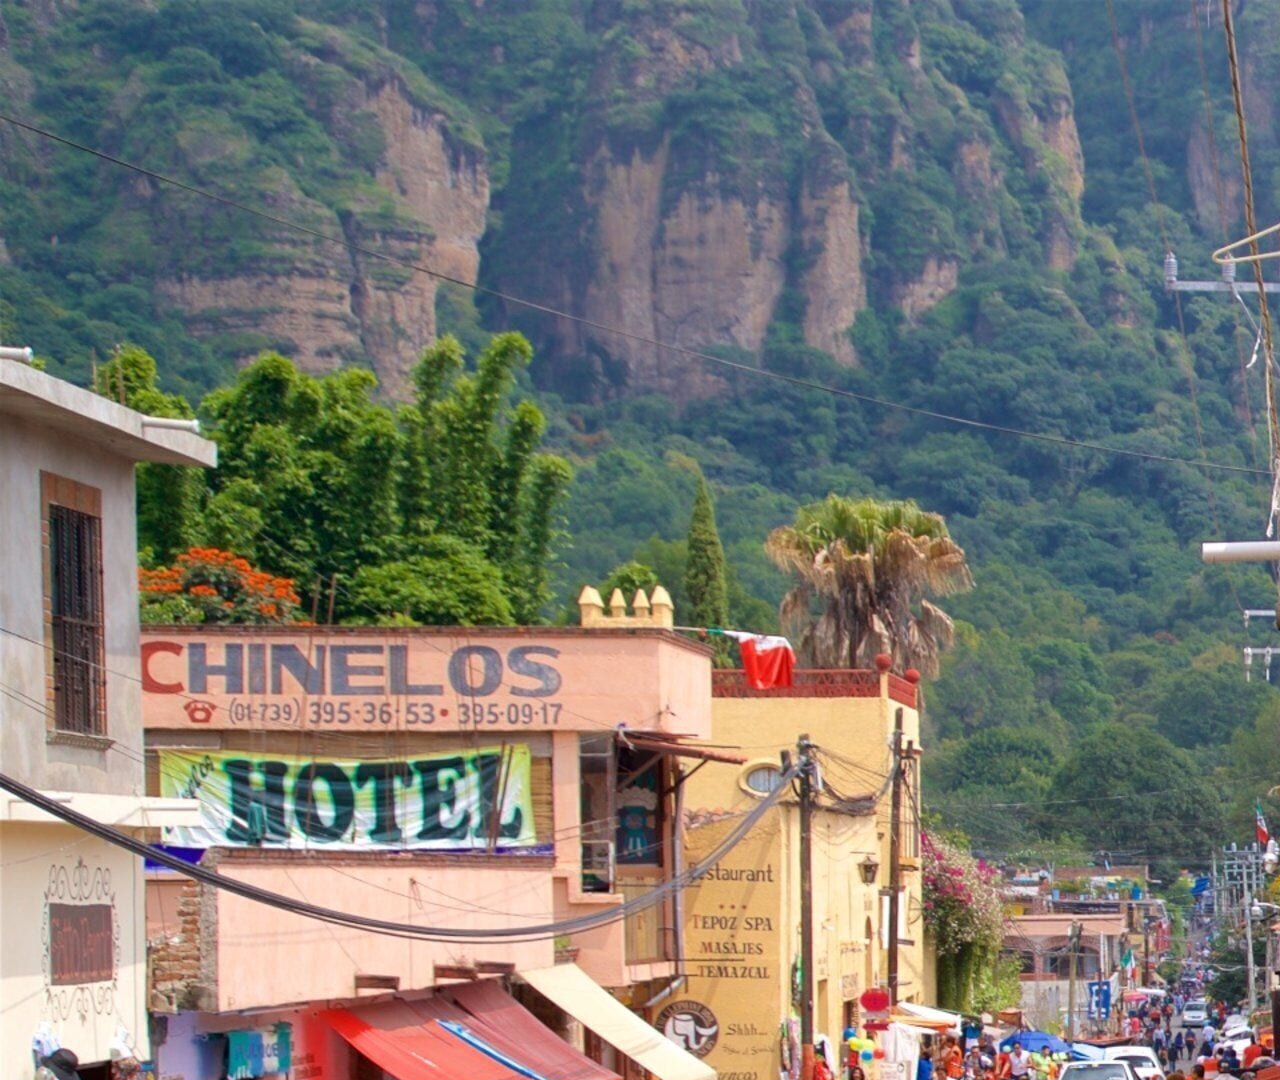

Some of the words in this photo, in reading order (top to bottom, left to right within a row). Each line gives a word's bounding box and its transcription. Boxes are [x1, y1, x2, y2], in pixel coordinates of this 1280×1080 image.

[140, 640, 562, 697] CHINELOS
[229, 699, 300, 724] (01-739)
[221, 754, 522, 843] HOTEL
[692, 914, 738, 930] TEPOZ
[743, 917, 773, 931] SPA
[699, 942, 764, 955] MASAJES
[697, 965, 770, 979] TEMAZCAL
